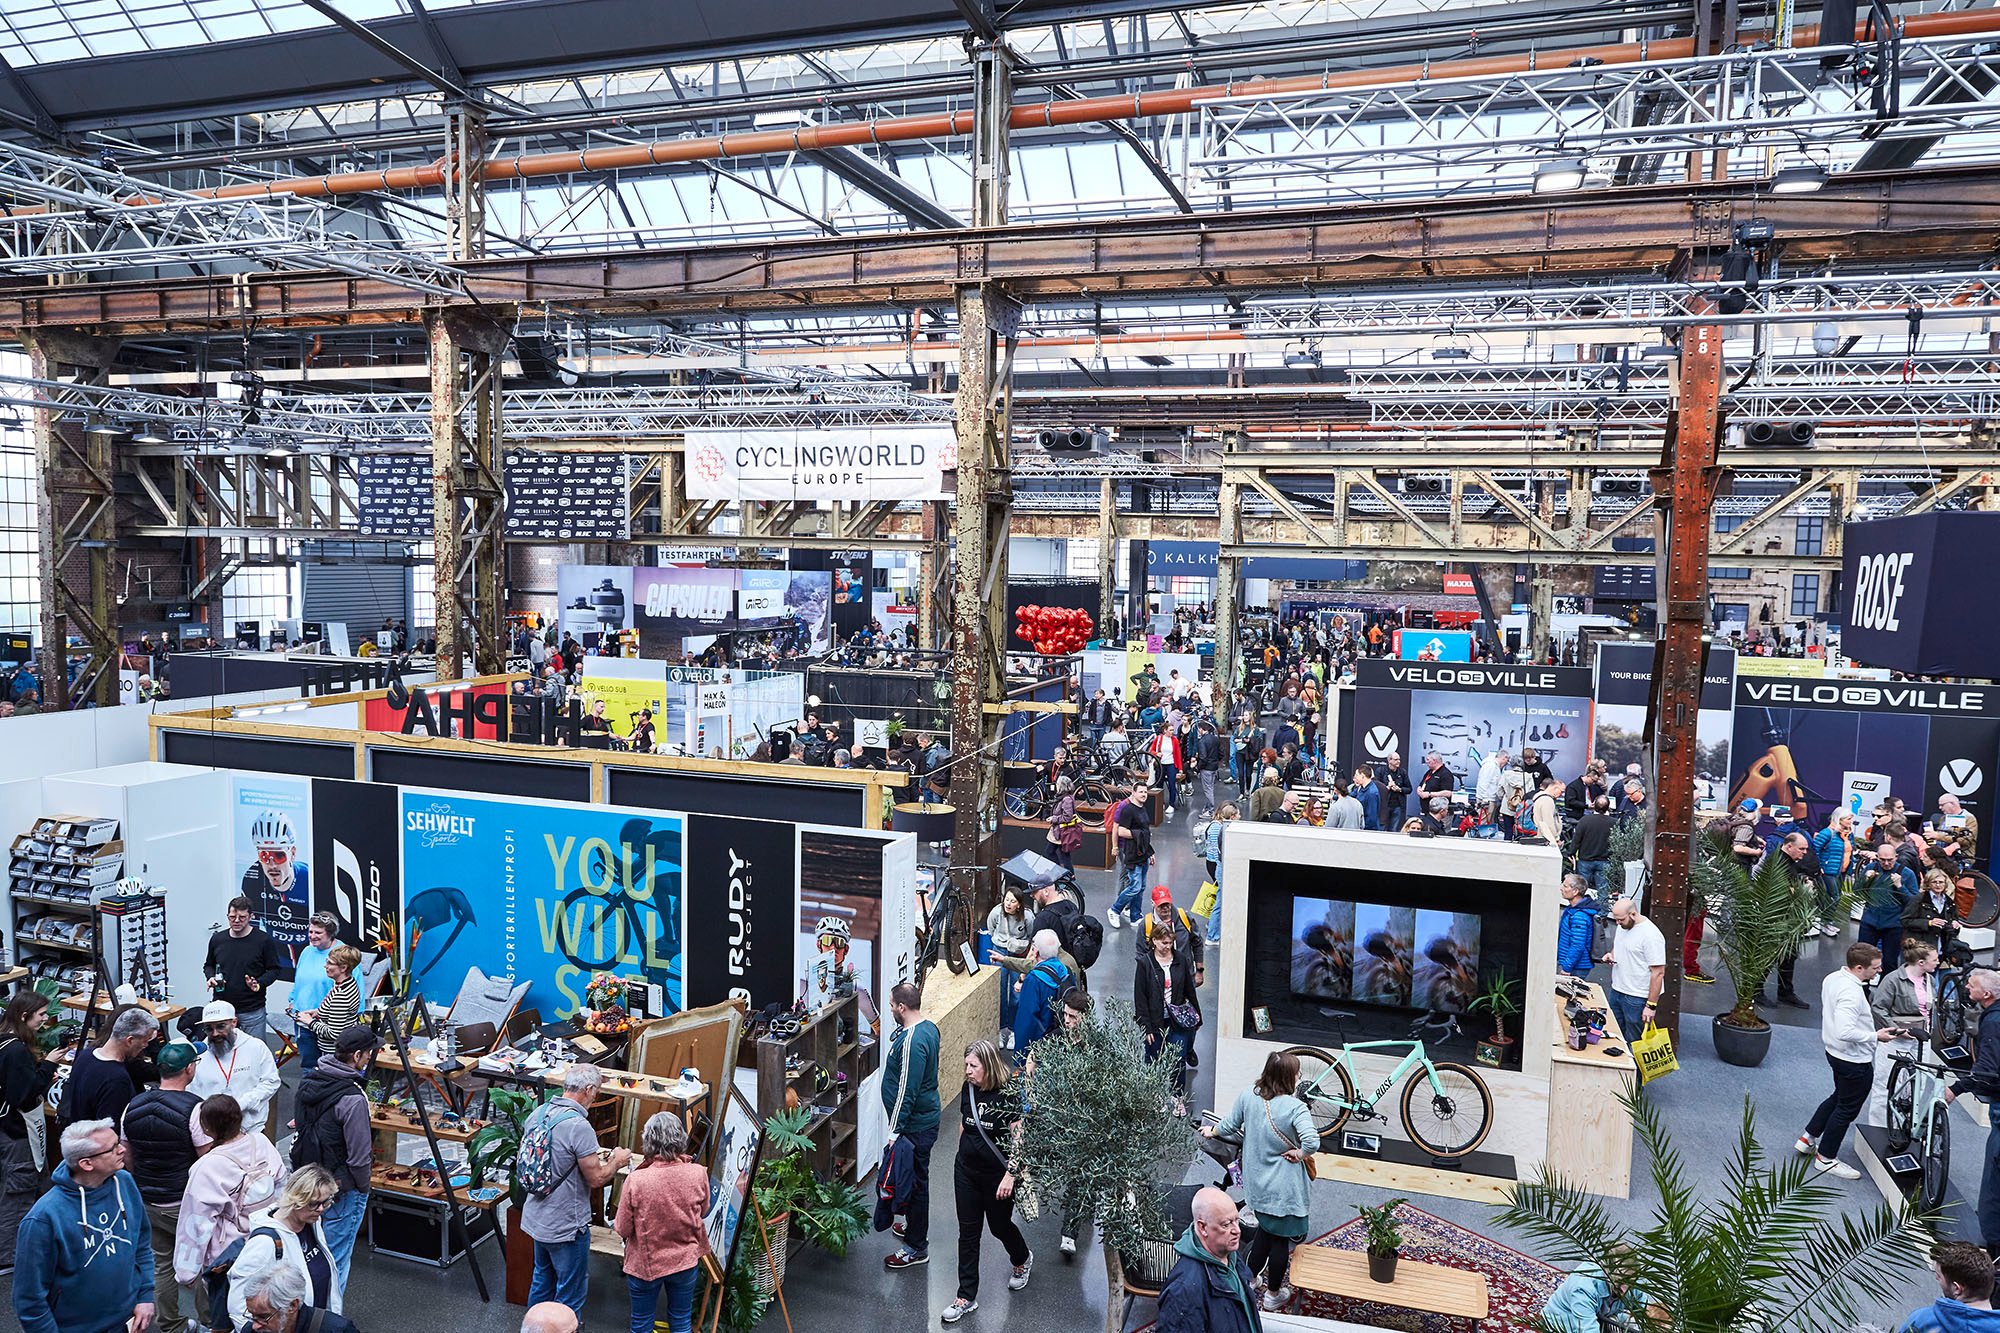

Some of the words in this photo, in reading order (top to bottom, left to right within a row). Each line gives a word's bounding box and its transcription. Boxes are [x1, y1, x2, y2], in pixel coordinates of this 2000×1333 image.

[736, 444, 926, 469] CYCLINGWORLD
[792, 473, 864, 485] EUROPE
[1360, 526, 1380, 541] 18
[660, 551, 722, 560] TESTFAHRTEN
[1165, 553, 1254, 565] KALKHF
[1851, 552, 1914, 632] ROSE
[1633, 672, 1652, 680] BIKE
[1704, 676, 1730, 684] MADE.
[407, 811, 476, 838] SEHWELT
[544, 833, 656, 902] YOU
[504, 829, 515, 980] SPORTBRILLENPROFI
[728, 847, 744, 976] RUDY
[272, 930, 294, 942] FDJ
[535, 897, 670, 970] WILL
[1642, 1043, 1673, 1064] DOWE
[1375, 1076, 1393, 1100] ROSE
